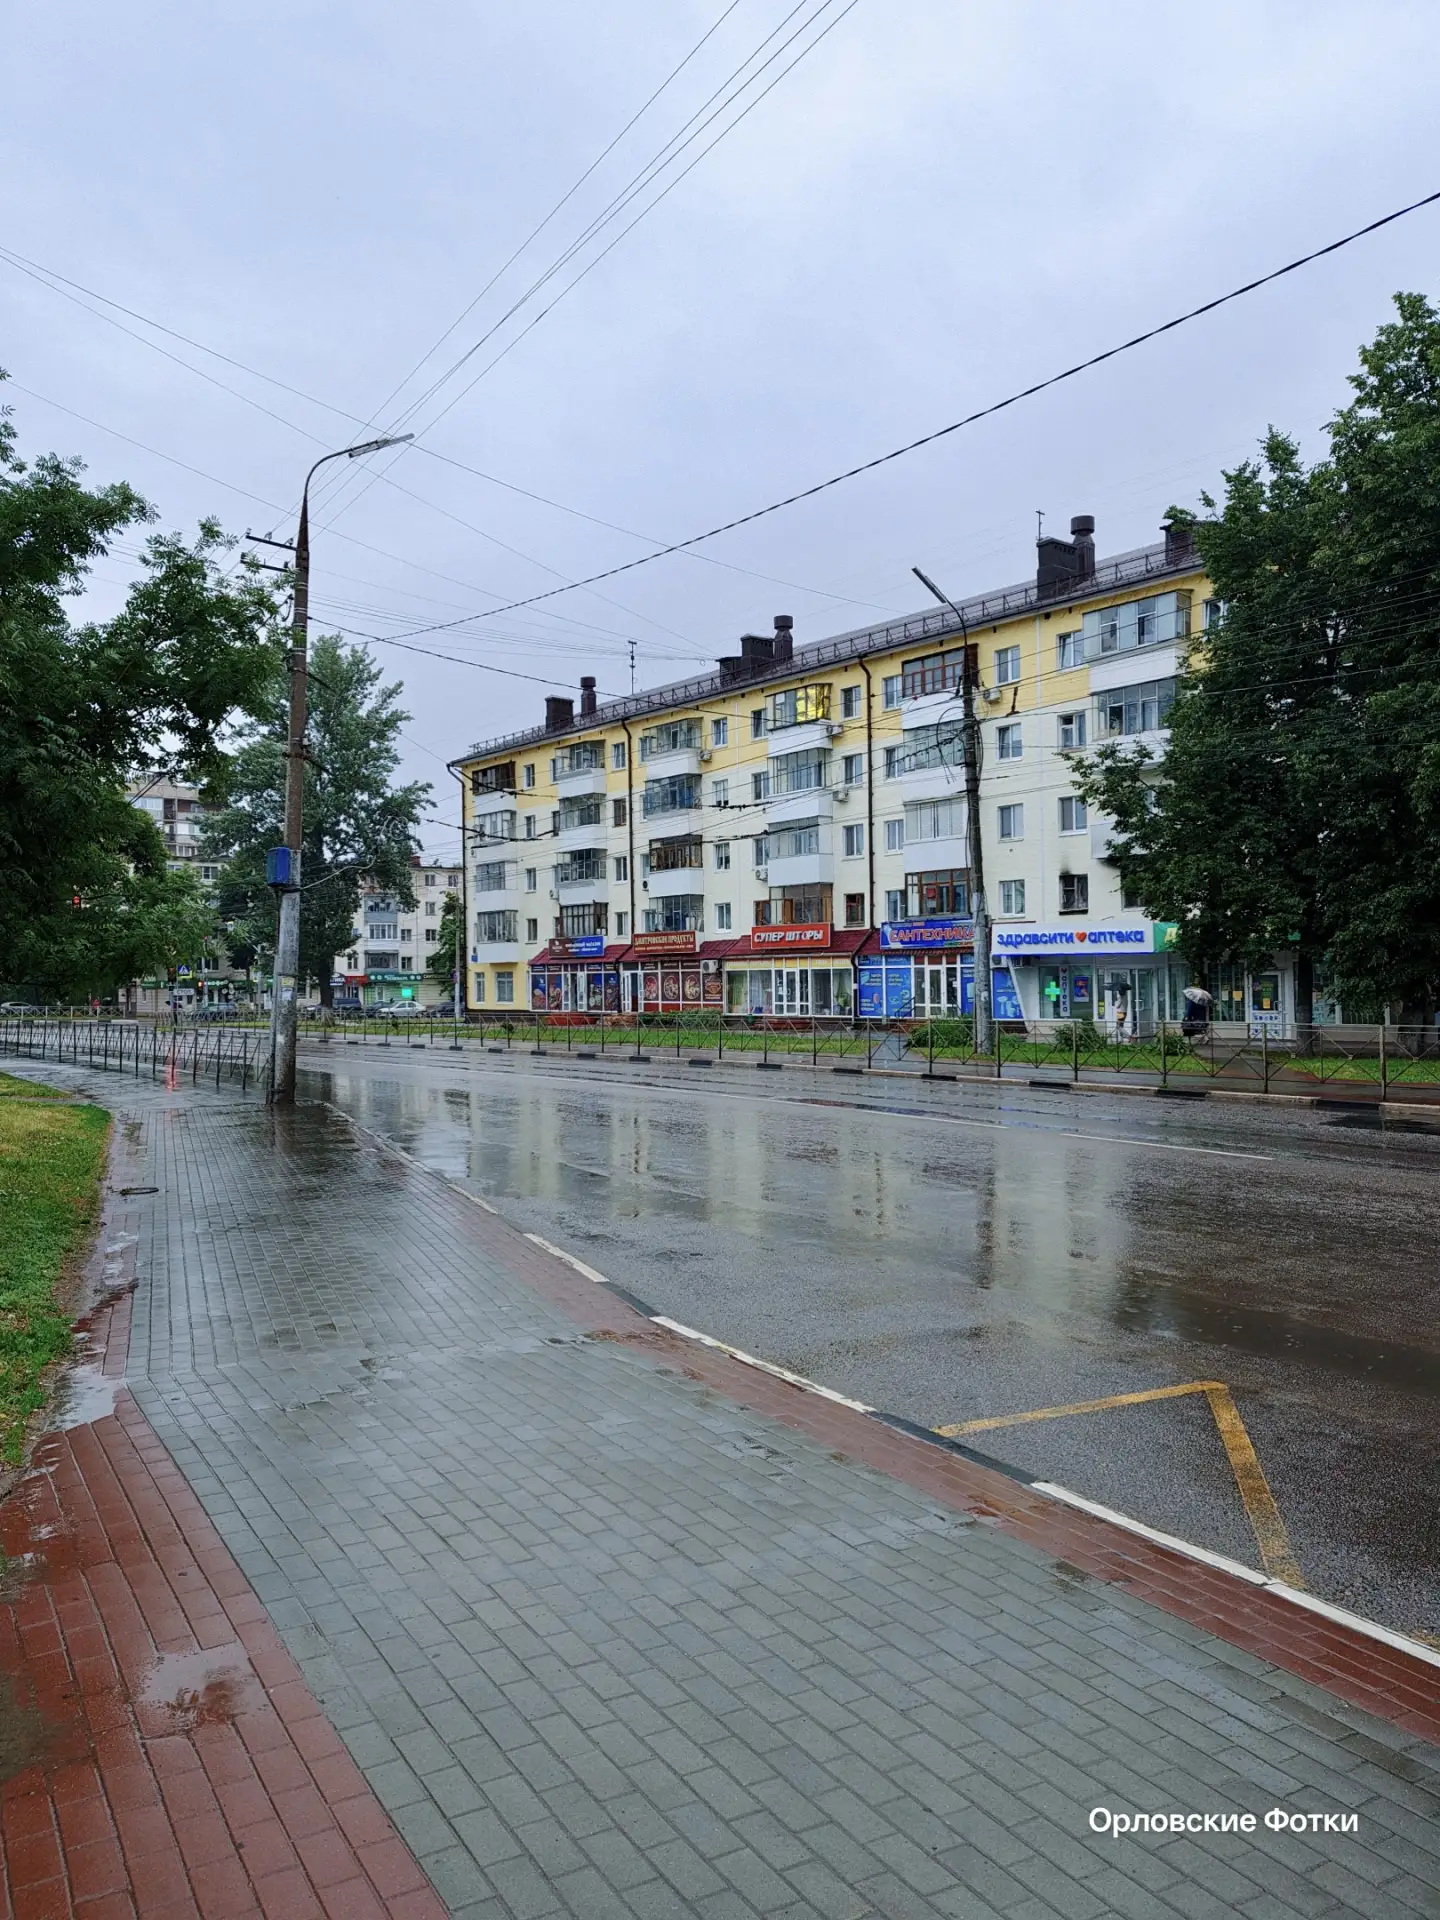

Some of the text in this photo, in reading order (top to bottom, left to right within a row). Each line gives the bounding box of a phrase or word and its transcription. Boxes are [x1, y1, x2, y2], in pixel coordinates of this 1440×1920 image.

[754, 929, 824, 943] СУПЕР ШТОРЫ
[996, 931, 1075, 949] здравсити
[1087, 930, 1145, 944] аптека
